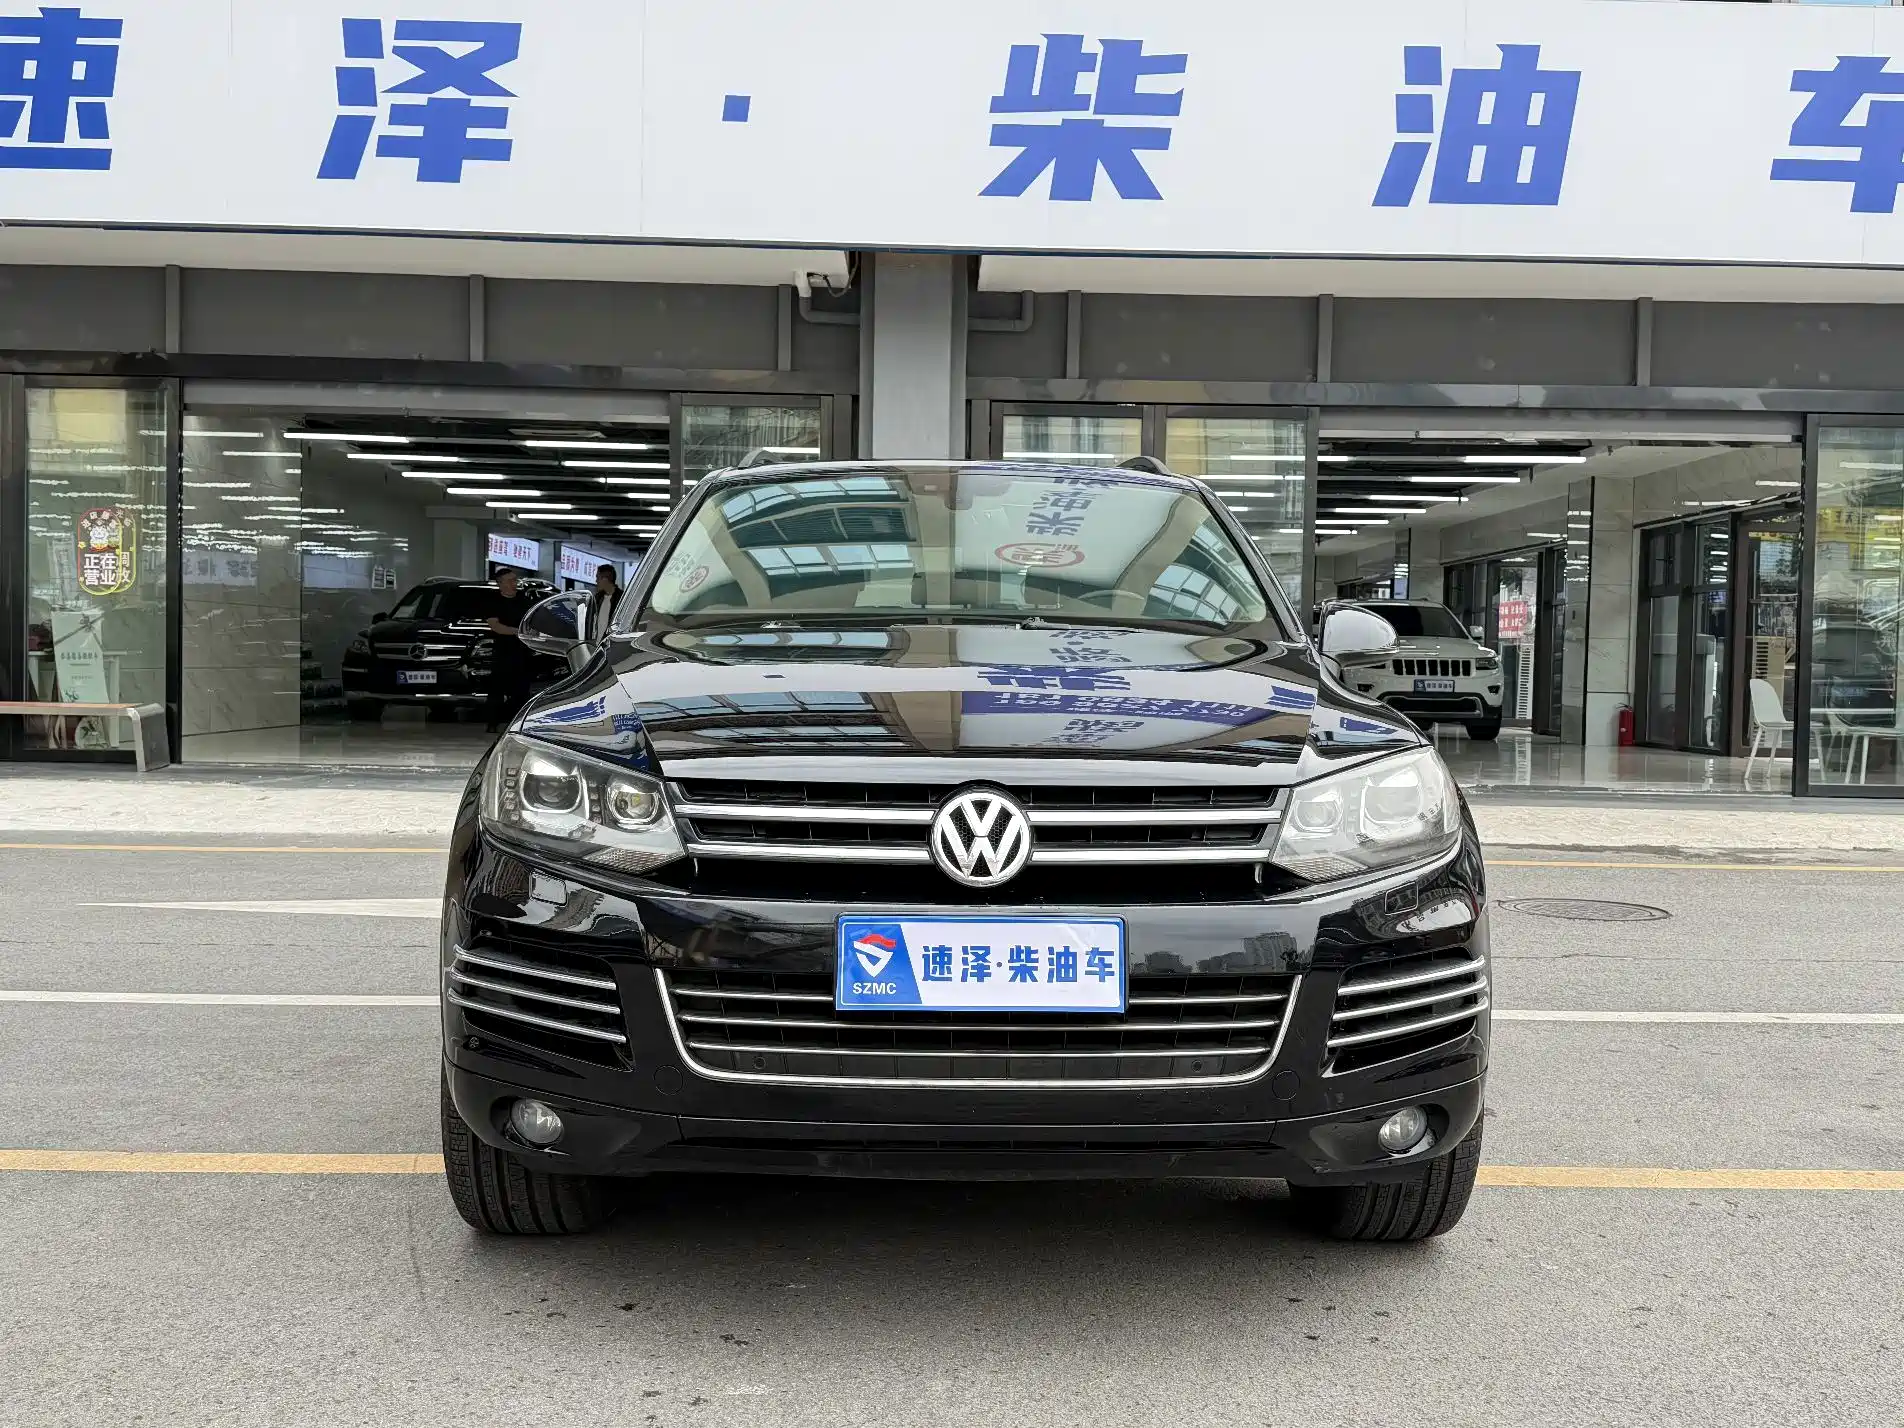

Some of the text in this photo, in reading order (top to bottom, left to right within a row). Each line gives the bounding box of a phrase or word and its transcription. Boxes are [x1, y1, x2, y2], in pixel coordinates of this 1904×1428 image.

[83, 553, 117, 569] 正在
[83, 569, 117, 586] 营业
[921, 944, 1115, 983] 速泽·柴油车
[852, 982, 897, 995] SZMC
